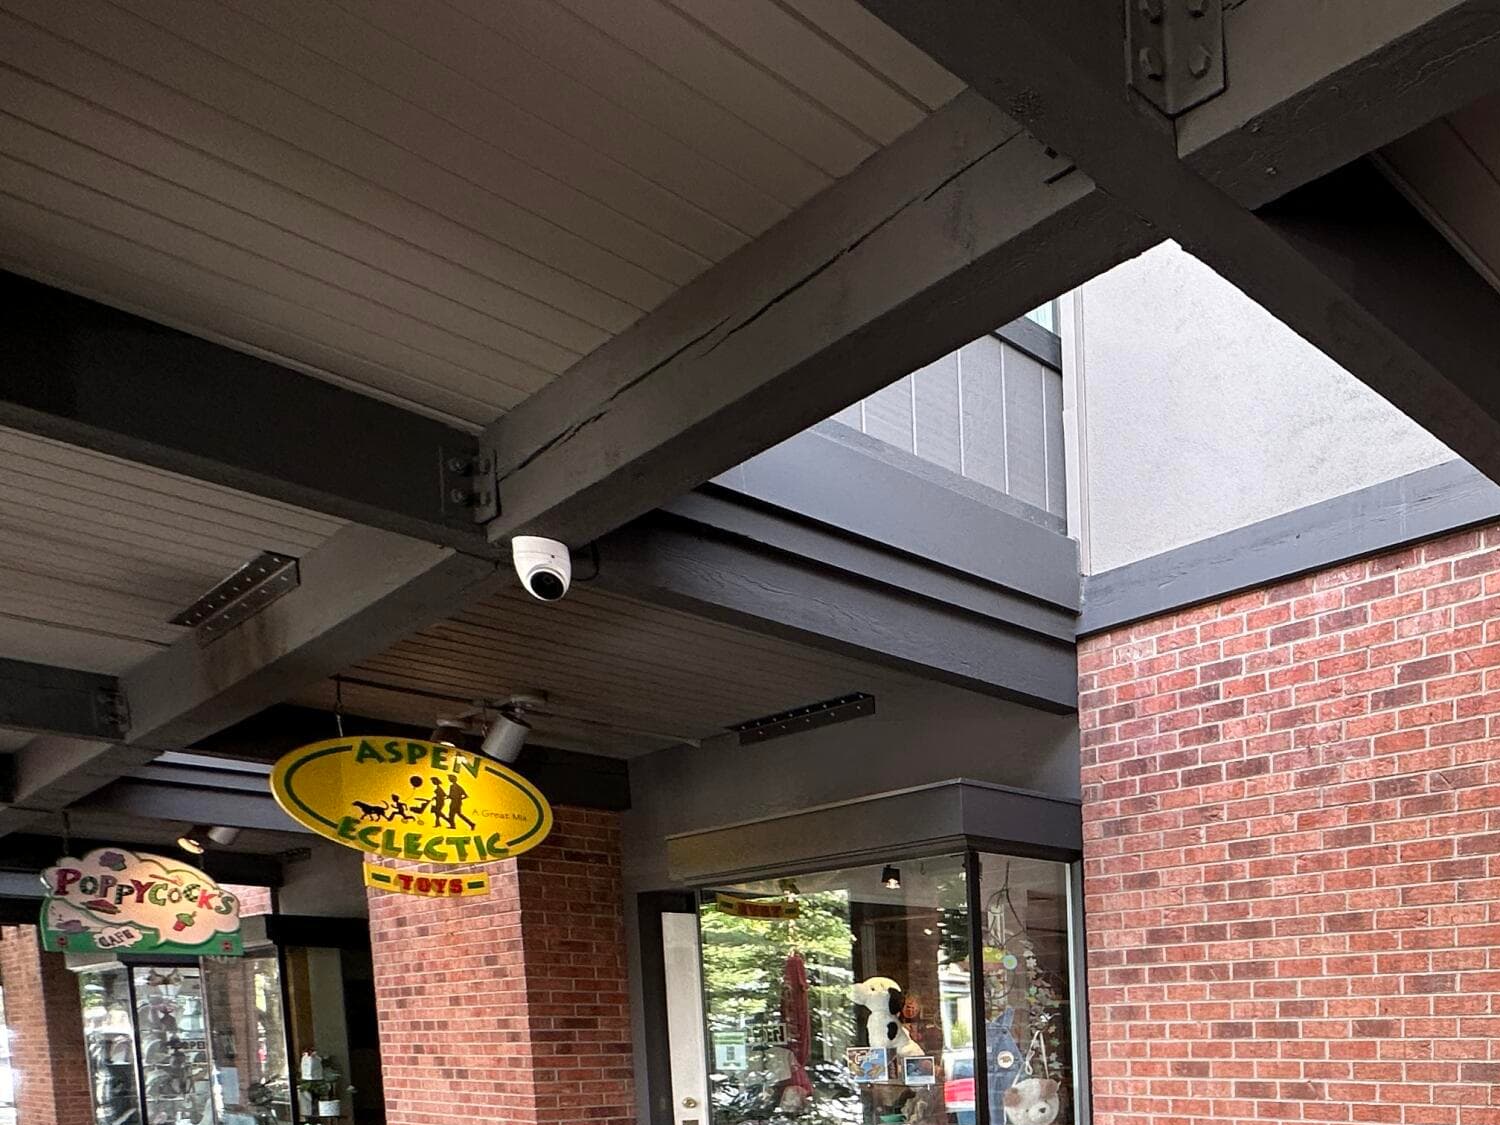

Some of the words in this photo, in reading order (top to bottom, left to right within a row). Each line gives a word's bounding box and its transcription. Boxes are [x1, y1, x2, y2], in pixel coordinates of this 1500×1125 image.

[355, 740, 481, 779] ASPEN
[337, 815, 510, 862] ECLECTIC
[54, 867, 235, 916] POPPYCOCK'S
[397, 874, 464, 894] TOYS
[98, 928, 135, 947] CAFE
